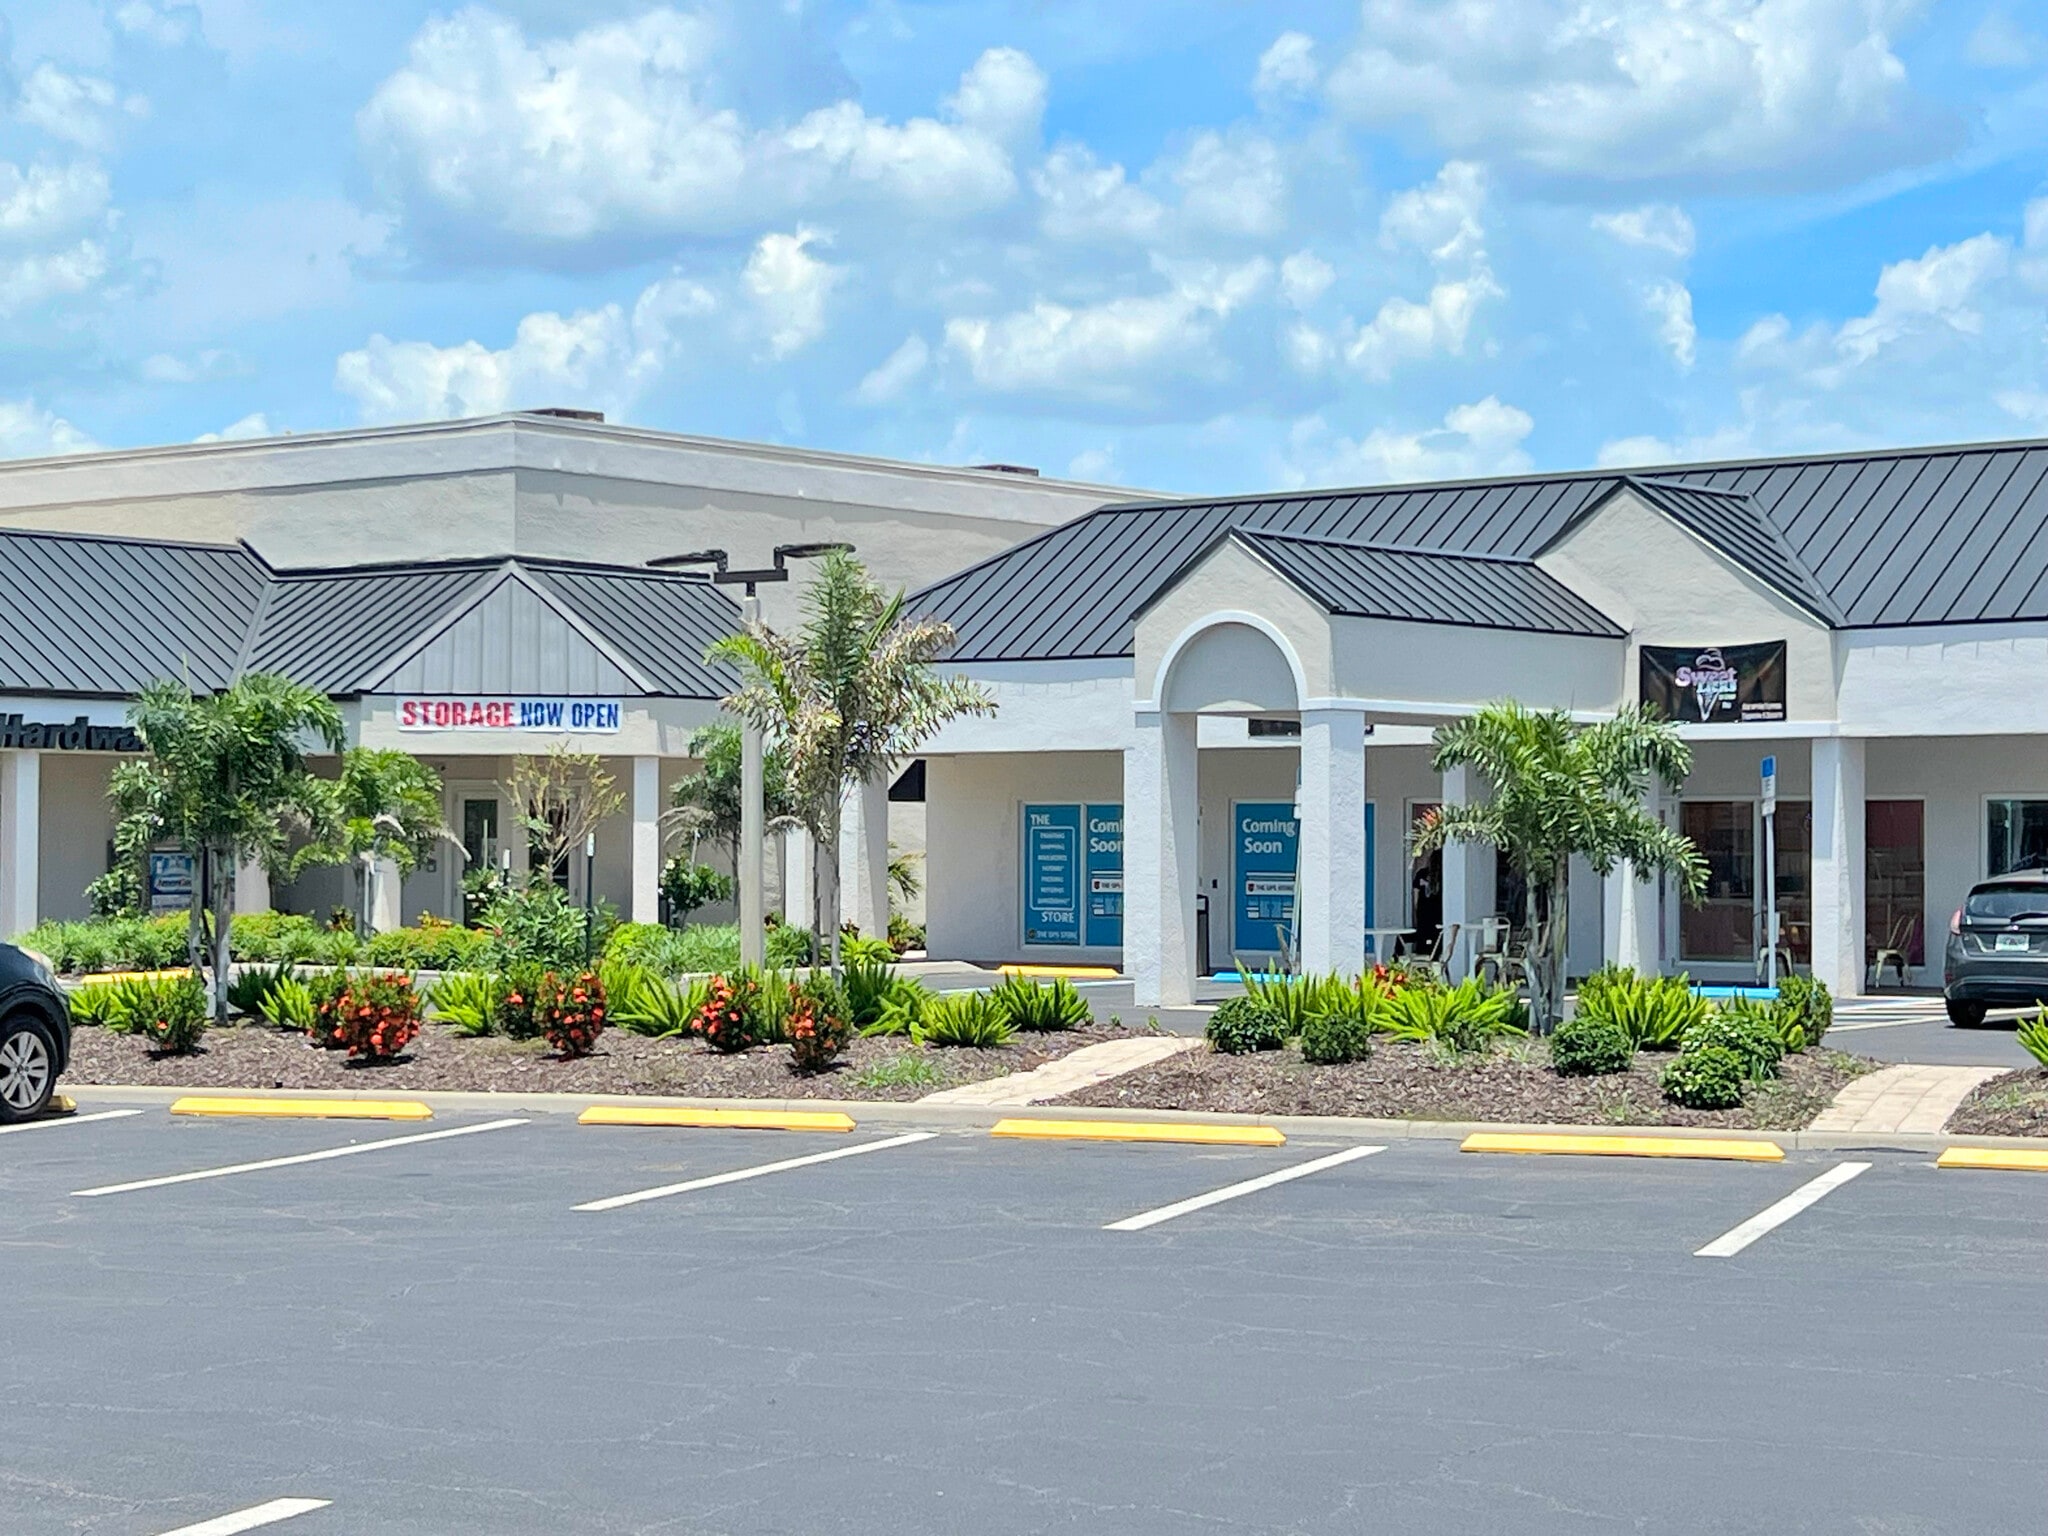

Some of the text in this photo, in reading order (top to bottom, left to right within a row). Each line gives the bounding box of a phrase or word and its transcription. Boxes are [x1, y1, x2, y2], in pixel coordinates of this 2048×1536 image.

[1675, 667, 1737, 687] Sweet
[403, 702, 618, 728] STORAGE NOW OPEN
[1030, 814, 1050, 825] THE
[1242, 819, 1296, 837] Coming
[1244, 838, 1283, 853] Soon
[1041, 911, 1075, 923] STORE
